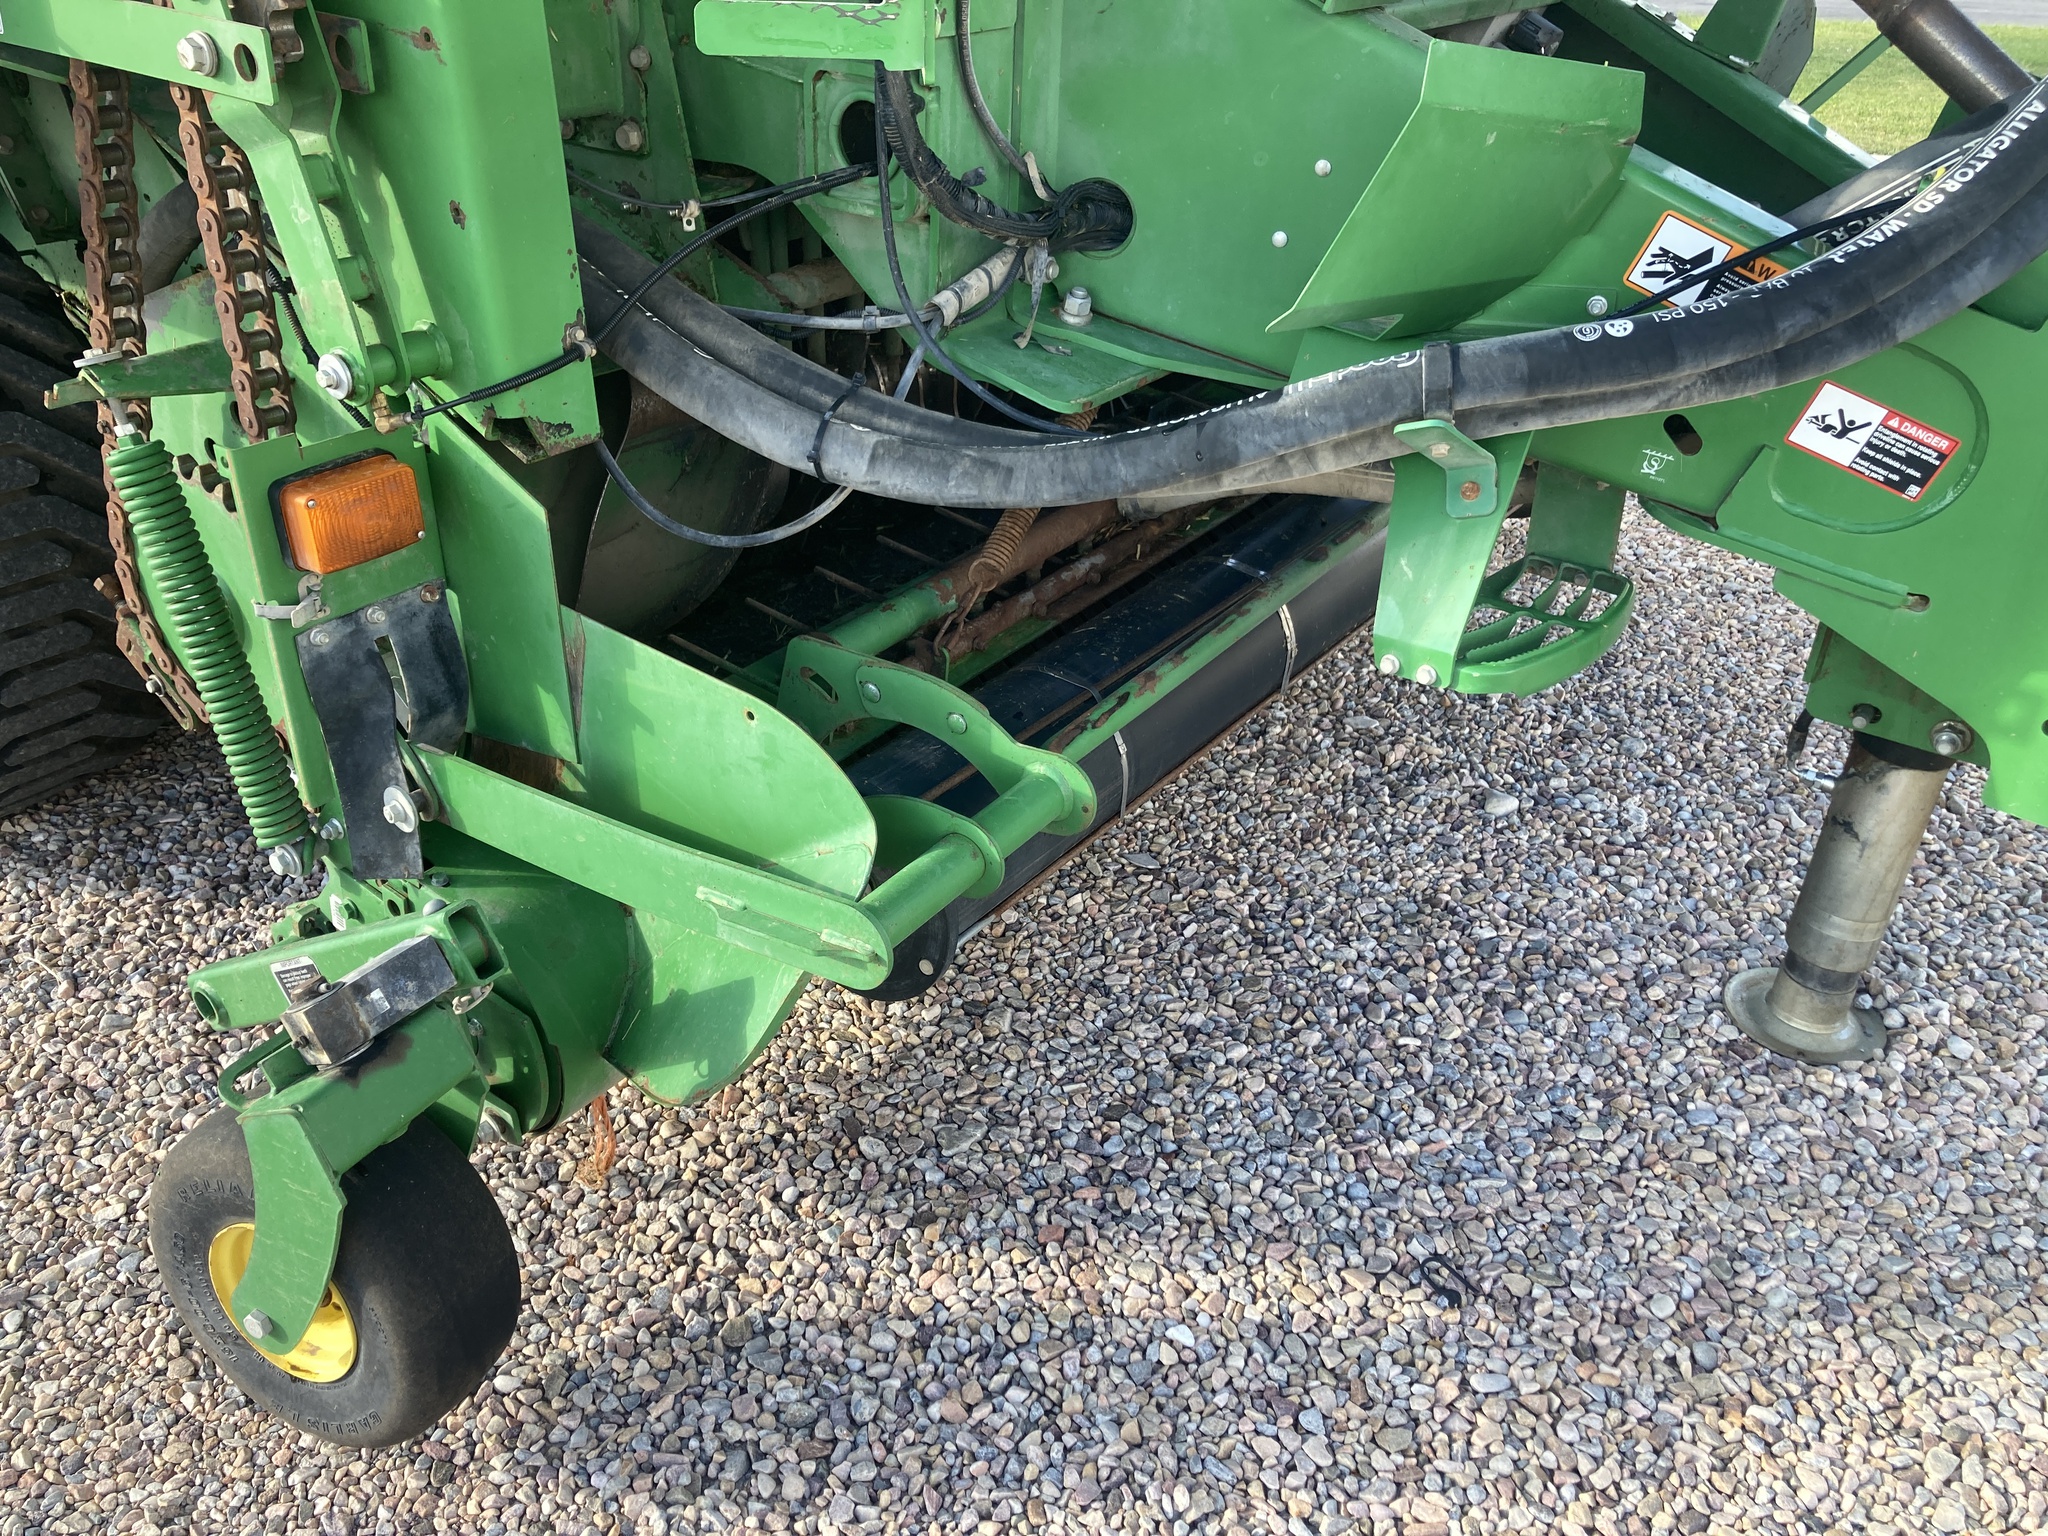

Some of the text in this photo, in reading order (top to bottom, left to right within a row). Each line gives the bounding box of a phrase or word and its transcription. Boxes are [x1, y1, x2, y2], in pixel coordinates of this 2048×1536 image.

[1941, 99, 2046, 194] ALLIGATOR
[1724, 271, 1739, 281] Avoid
[1653, 308, 1686, 323] PSI
[1690, 299, 1728, 314] 150
[1869, 436, 1885, 447] injury
[1890, 446, 1906, 457] death.
[1877, 426, 1912, 446] Entanglement
[1916, 444, 1937, 457] rotating
[1900, 422, 1948, 450] DANGER
[1873, 431, 1896, 444] driveline
[1905, 445, 1921, 456] cause
[1920, 453, 1940, 465] serious
[1850, 463, 1885, 481] rotating parts.
[1854, 457, 1899, 480] Avoid contact with
[1861, 446, 1875, 456] Keep
[1881, 456, 1901, 468] shields
[1905, 467, 1922, 478] place.
